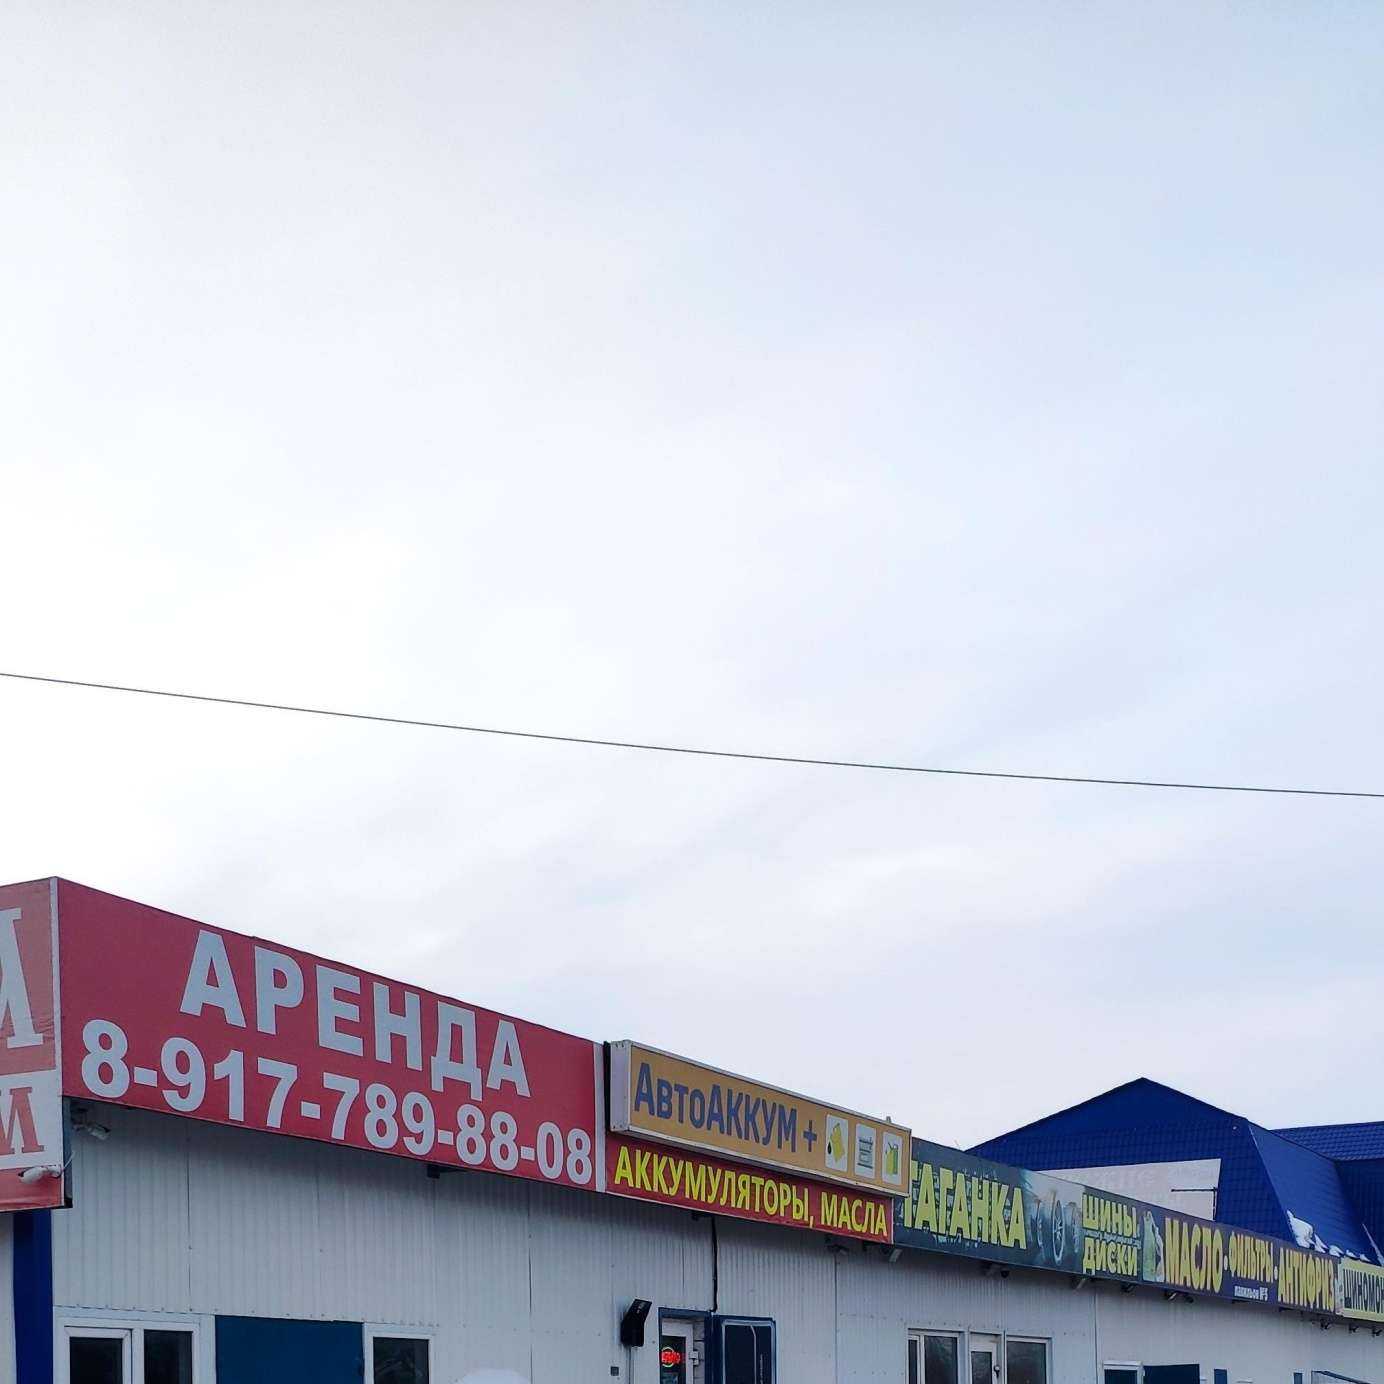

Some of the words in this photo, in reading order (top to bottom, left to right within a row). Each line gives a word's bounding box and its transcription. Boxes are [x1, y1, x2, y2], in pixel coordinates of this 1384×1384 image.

[180, 929, 531, 1101] АРЕНДА
[81, 1019, 592, 1185] 8-917-789-88-08
[615, 1146, 814, 1228] АККУМУЛЯТОРЫ,
[820, 1192, 888, 1236] МАСЛА
[1083, 1194, 1137, 1238] ШИНЫ
[1083, 1237, 1137, 1276] ДИСКИ
[1165, 1217, 1223, 1293] МАСЛО
[1229, 1232, 1273, 1283] ФИЛЬТРЫ
[1278, 1248, 1335, 1312] АНТИФРИЗ
